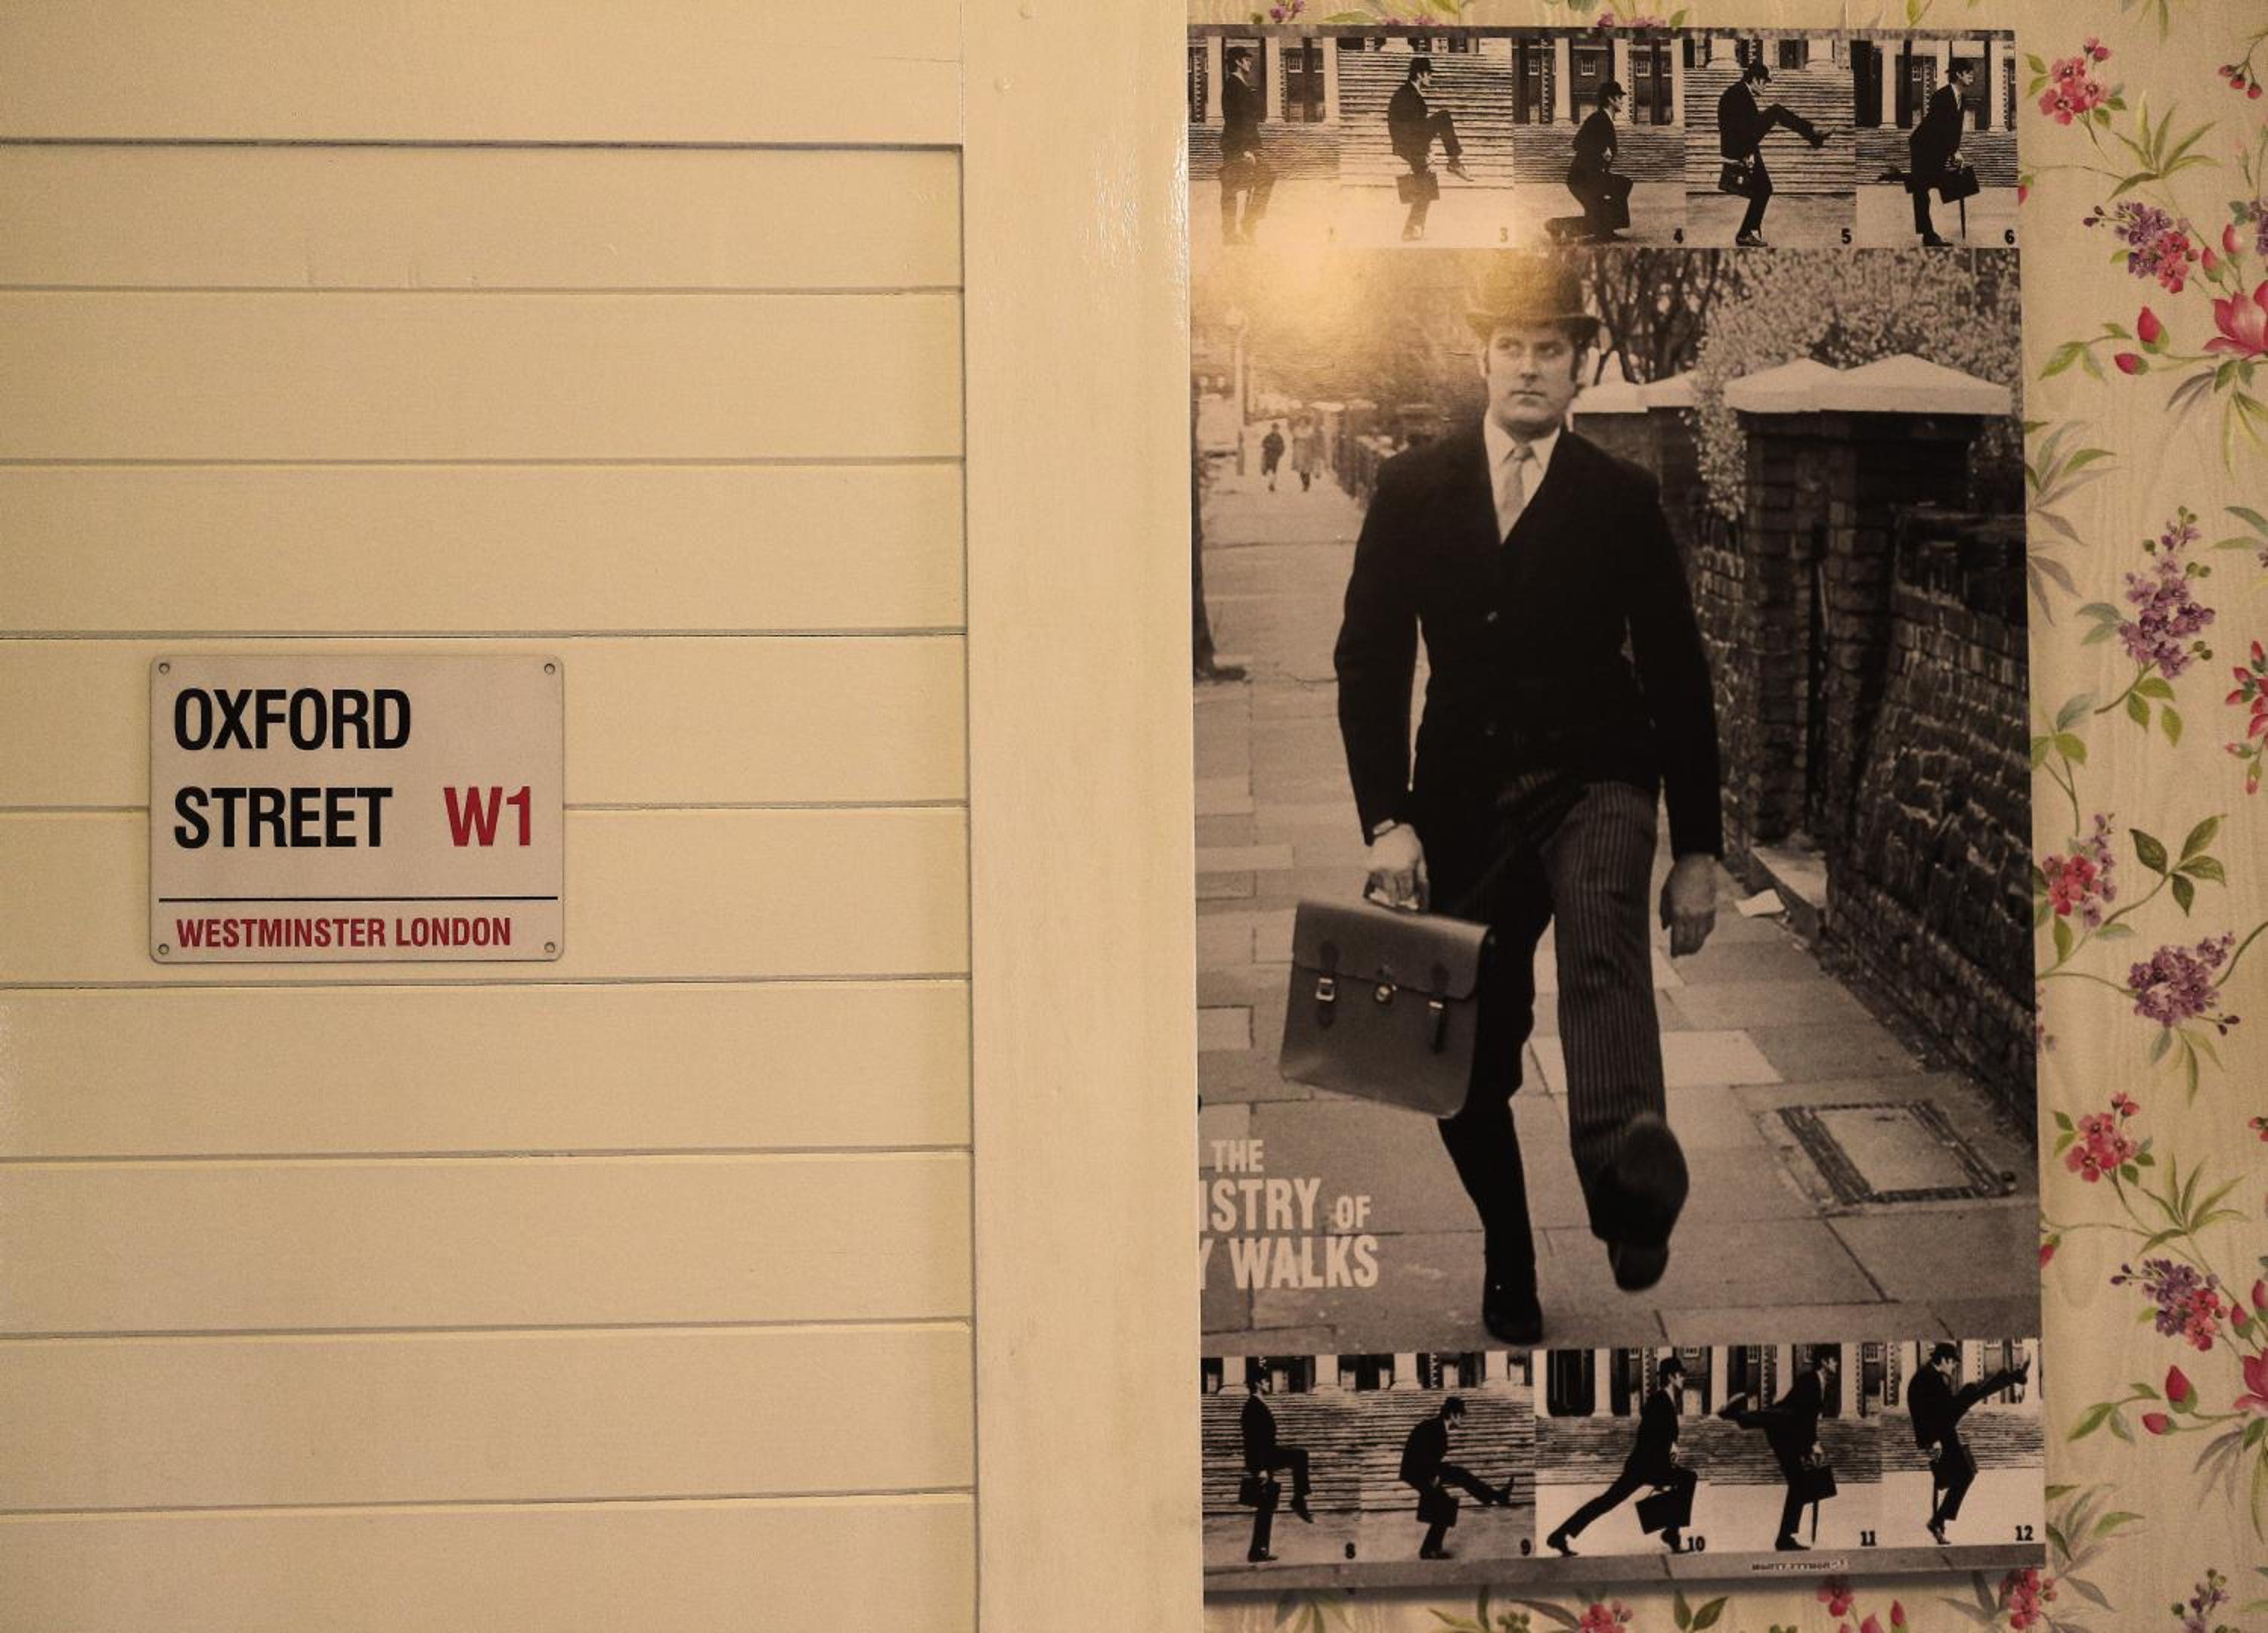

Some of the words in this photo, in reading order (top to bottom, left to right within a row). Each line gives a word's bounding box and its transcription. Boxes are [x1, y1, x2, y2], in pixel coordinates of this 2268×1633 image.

[1500, 227, 1509, 243] 3
[1673, 228, 1684, 243] 4
[1841, 228, 1851, 243] 5
[2004, 229, 2015, 244] 6
[174, 687, 411, 750] OXFORD
[174, 786, 392, 848] STREET
[443, 786, 531, 847] W1
[176, 917, 385, 947] WESTMINSTER
[395, 917, 511, 947] LONDON
[1212, 1139, 1263, 1172] THE
[1336, 1196, 1371, 1229] OF
[1229, 1235, 1379, 1288] WALKS
[1860, 1531, 1876, 1547] 11
[2015, 1526, 2034, 1542] 12
[1346, 1543, 1356, 1559] 8
[1520, 1538, 1531, 1555] 9
[1687, 1535, 1706, 1552] 10
